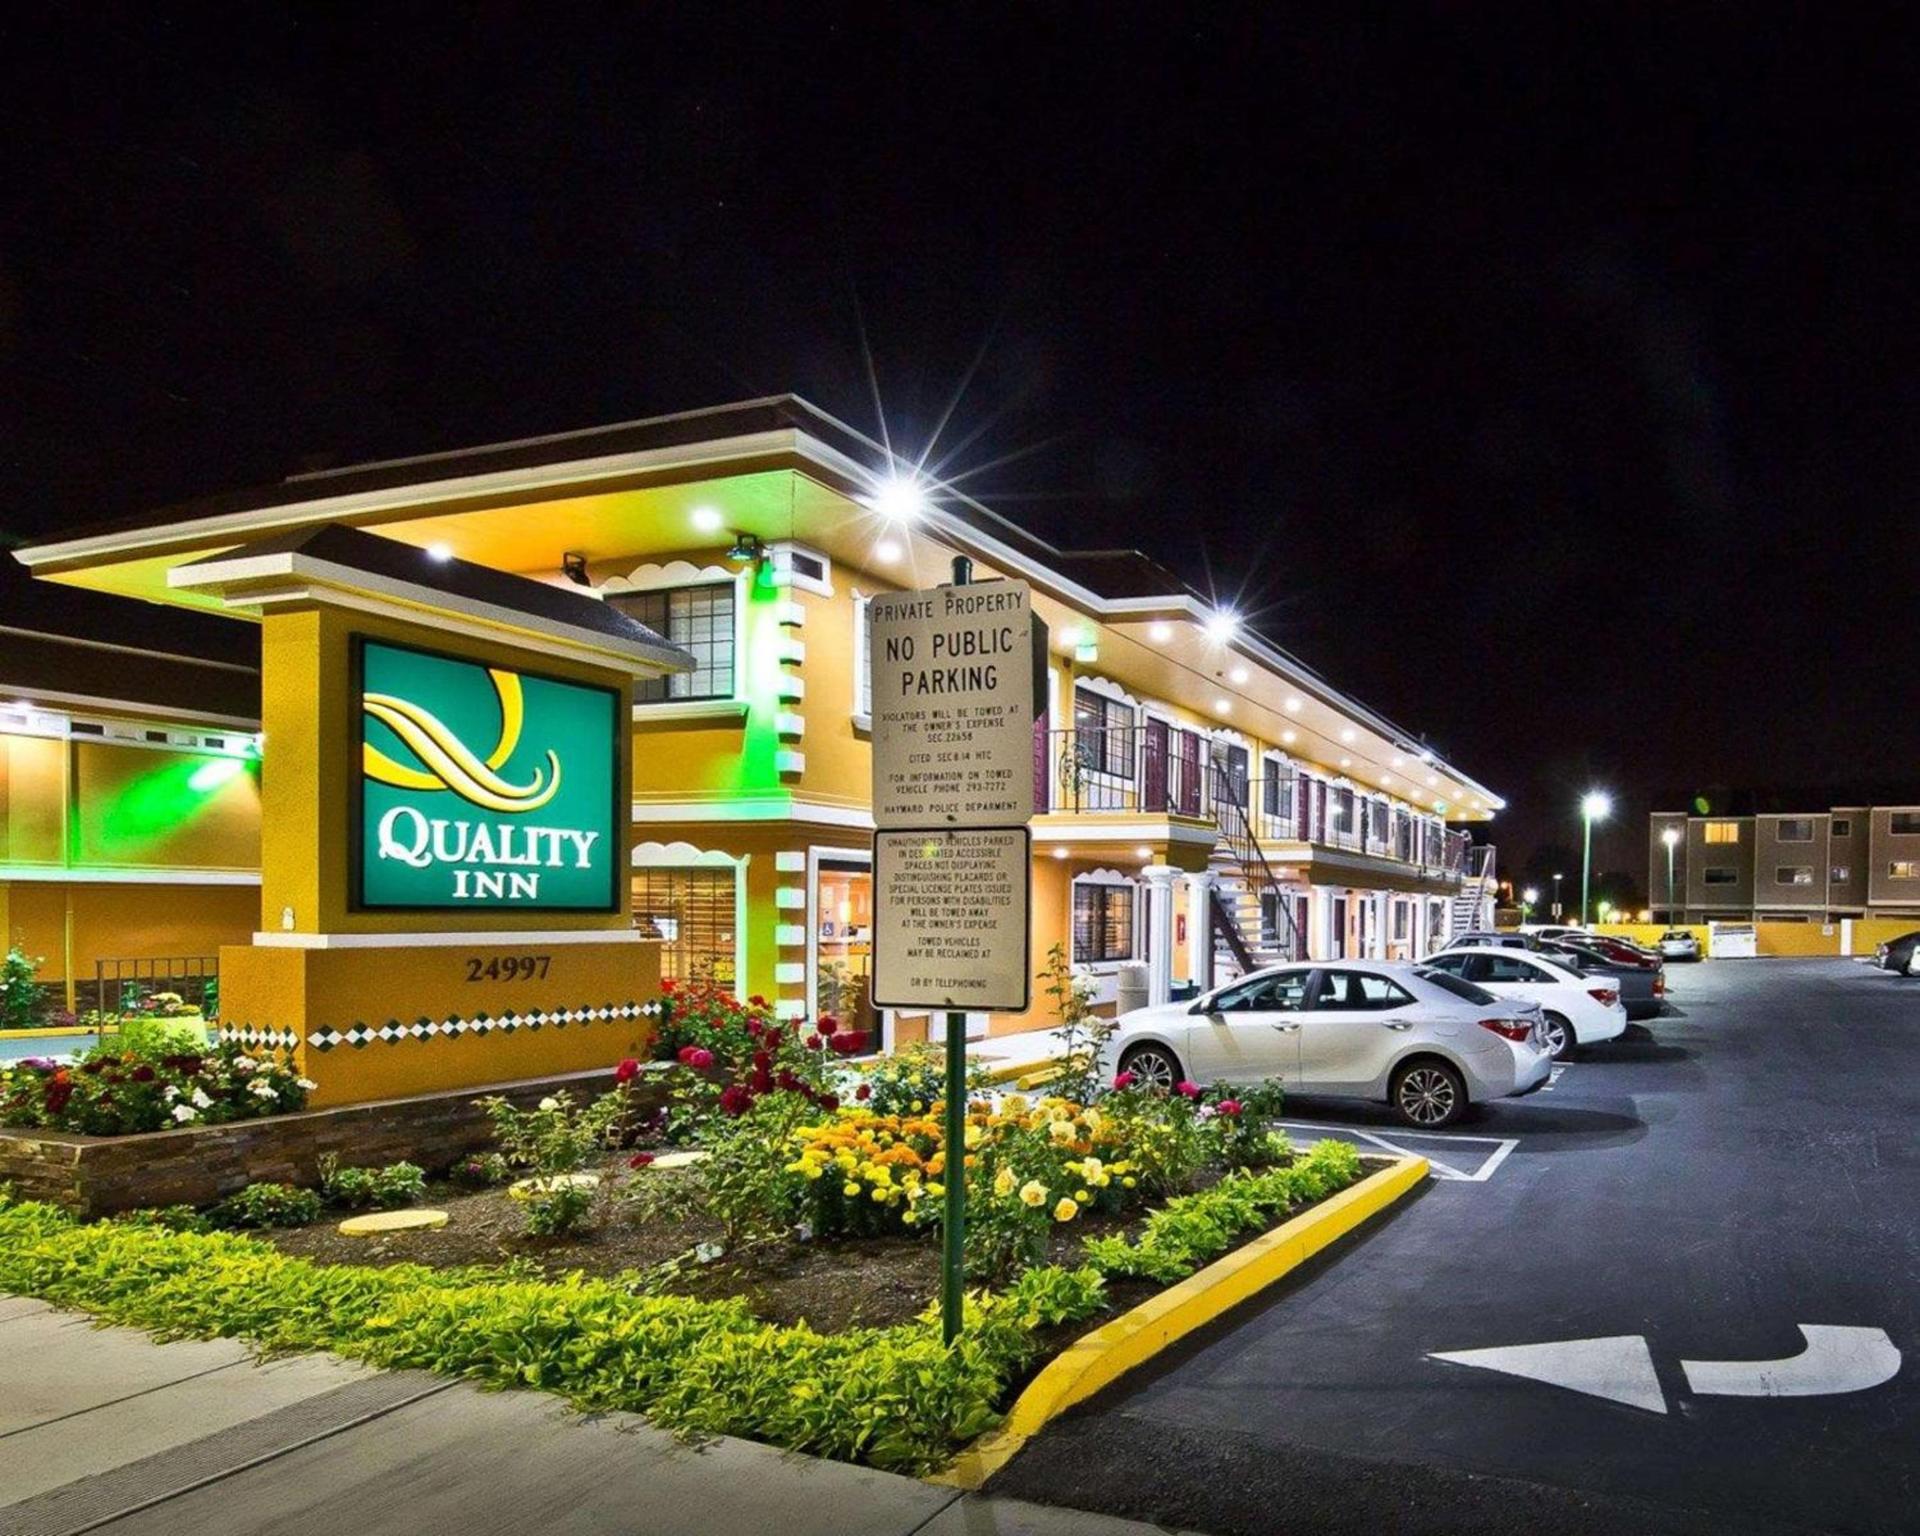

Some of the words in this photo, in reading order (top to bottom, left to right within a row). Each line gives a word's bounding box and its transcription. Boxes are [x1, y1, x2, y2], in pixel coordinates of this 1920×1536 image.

[875, 601, 933, 622] PRIVATE
[946, 592, 1022, 616] PROPERTY
[887, 636, 914, 661] NO
[933, 627, 1012, 658] PUBLIC
[902, 665, 997, 695] PARKING
[882, 711, 926, 721] VIOLATORS
[932, 710, 951, 719] WILL
[957, 708, 968, 718] BE
[974, 706, 1003, 716] TOWED
[1009, 705, 1019, 714] AT
[903, 723, 918, 732] THE
[967, 718, 1005, 729] EXPENSE
[909, 753, 931, 763] CITED
[889, 774, 905, 783] FOR
[910, 771, 963, 782] INFORMATION
[968, 771, 979, 780] ON
[986, 769, 1013, 779] TOWED
[896, 784, 927, 794] VEHICLE
[933, 783, 960, 793] PHONE
[884, 804, 923, 813] HAYWARD
[929, 803, 959, 813] POLICE
[378, 806, 599, 868] QUALITY
[945, 836, 981, 846] VEHICLES
[983, 835, 1014, 845] PARKED
[899, 849, 906, 858] IN
[909, 849, 953, 858] DESATED
[956, 848, 1001, 858] ACCESSIBLE
[904, 861, 933, 870] SPACES
[935, 861, 950, 870] NOT
[951, 860, 996, 869] DISPLAYING
[894, 873, 952, 882] DISTINGUISHING
[954, 872, 994, 882] PLACARDS
[996, 872, 1007, 881] OR
[452, 870, 540, 899] INN
[889, 885, 918, 894] SPECIAL
[921, 884, 952, 894] LICENSE
[954, 884, 983, 893] PLATES
[985, 884, 1012, 893] ISSUED
[890, 896, 906, 905] FOR
[907, 896, 941, 905] PERSONS
[944, 896, 960, 905] WITH
[963, 896, 1011, 906] DISABILITIES
[910, 908, 927, 917] WILL
[929, 908, 938, 917] BE
[942, 908, 966, 917] TOWED
[968, 908, 989, 917] AWAY
[901, 920, 911, 929] AT
[913, 920, 926, 929] THE
[964, 920, 998, 929] EXPENSE
[918, 937, 942, 946] TOWED
[945, 937, 980, 946] VEHICLES
[907, 949, 922, 958] MAY
[925, 949, 935, 958] BE
[937, 949, 979, 959] RECLAIMED
[981, 949, 991, 958] AT
[466, 956, 551, 982] 24997
[911, 978, 921, 987] OR
[922, 978, 933, 987] BY
[935, 978, 987, 988] TELEPHONING
